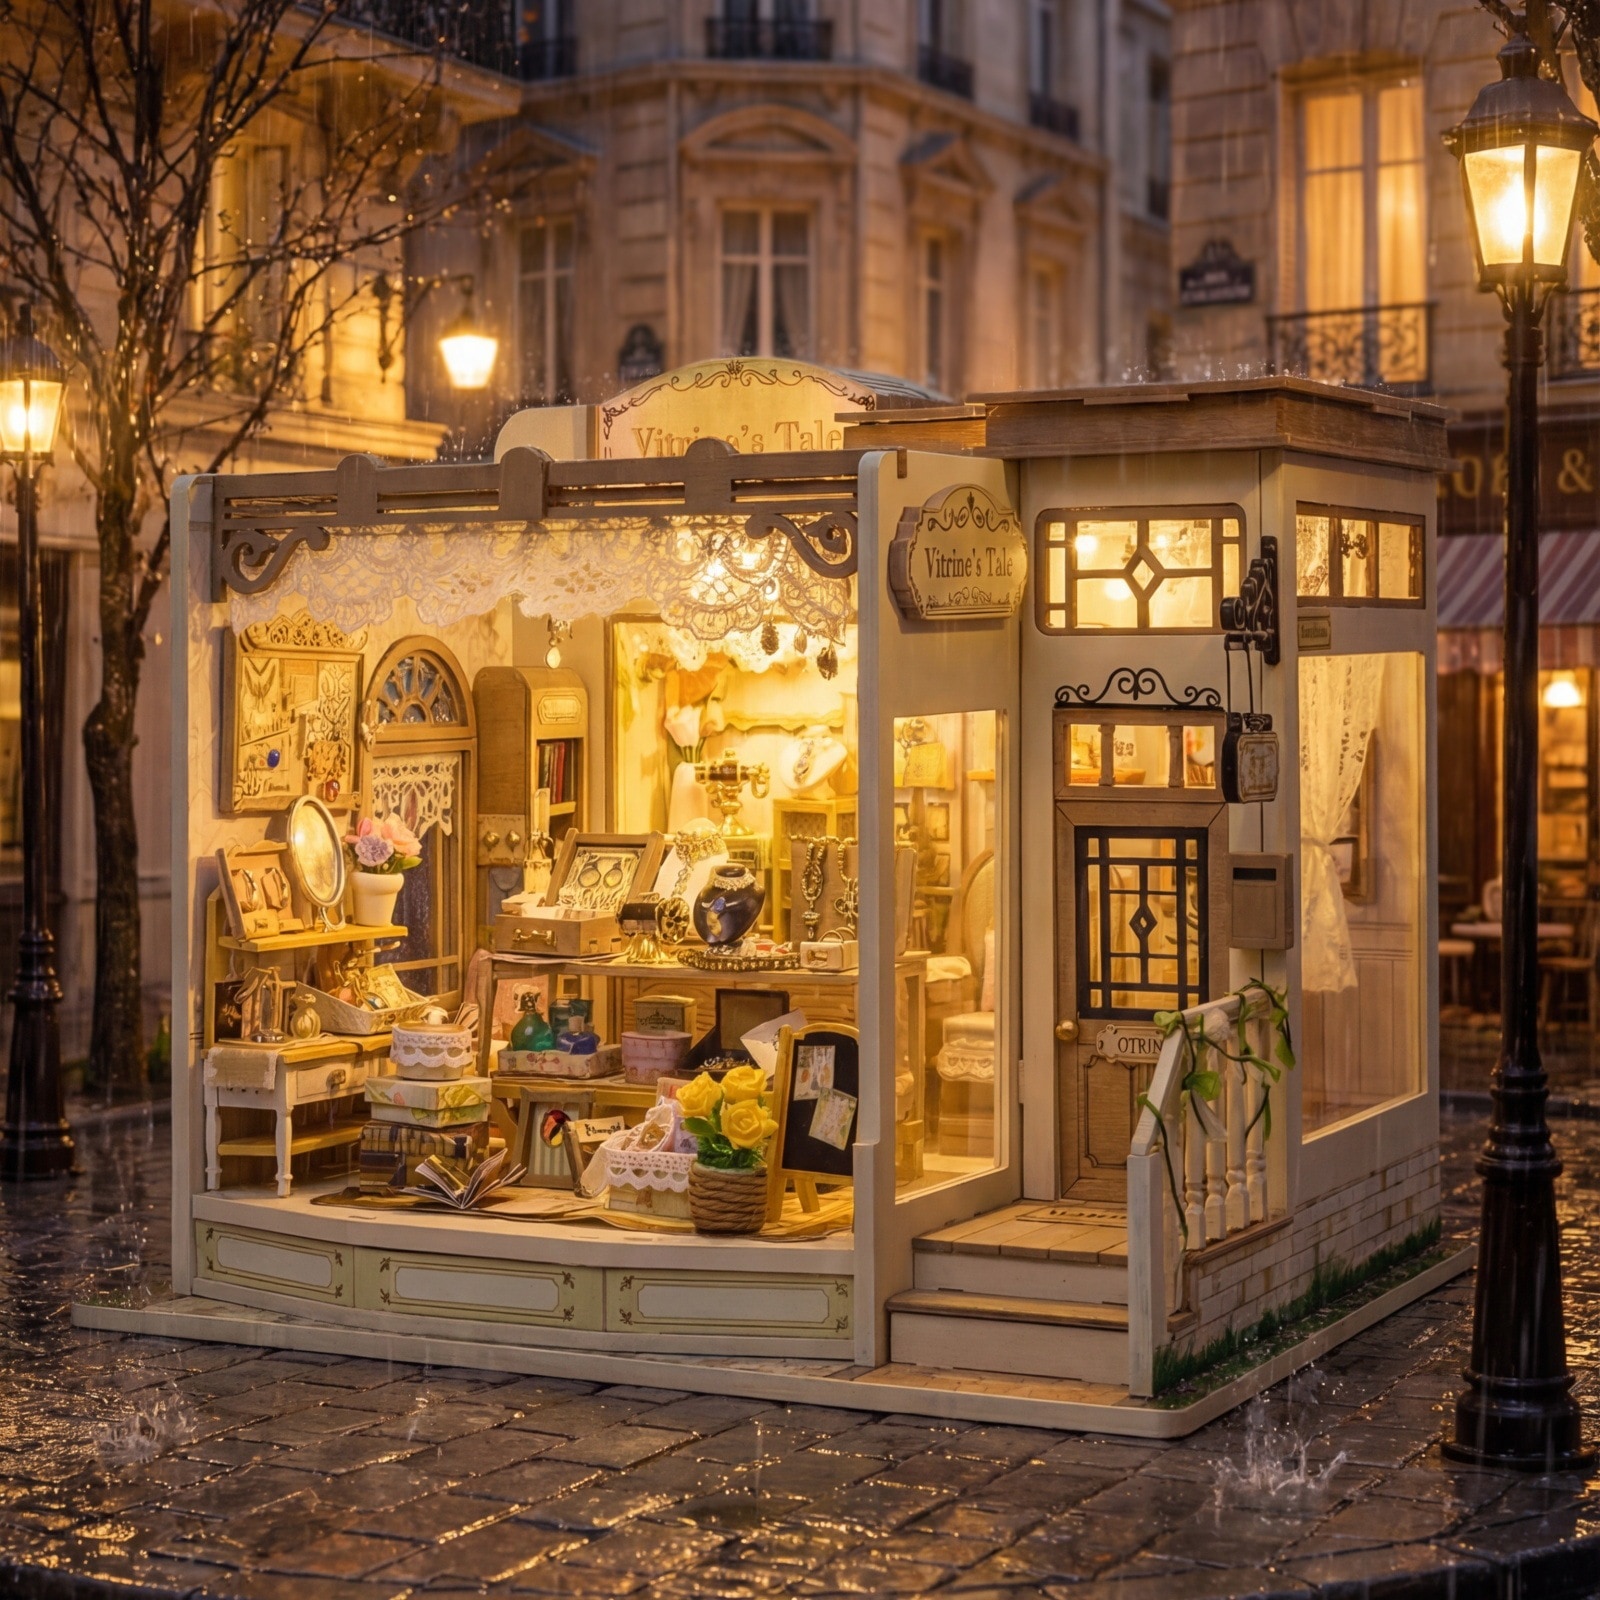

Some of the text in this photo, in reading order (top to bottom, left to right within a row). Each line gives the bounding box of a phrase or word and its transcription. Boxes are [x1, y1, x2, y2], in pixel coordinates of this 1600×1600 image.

[632, 420, 842, 458] Vitrie's Tale
[924, 547, 1013, 578] Vitrine's Tale
